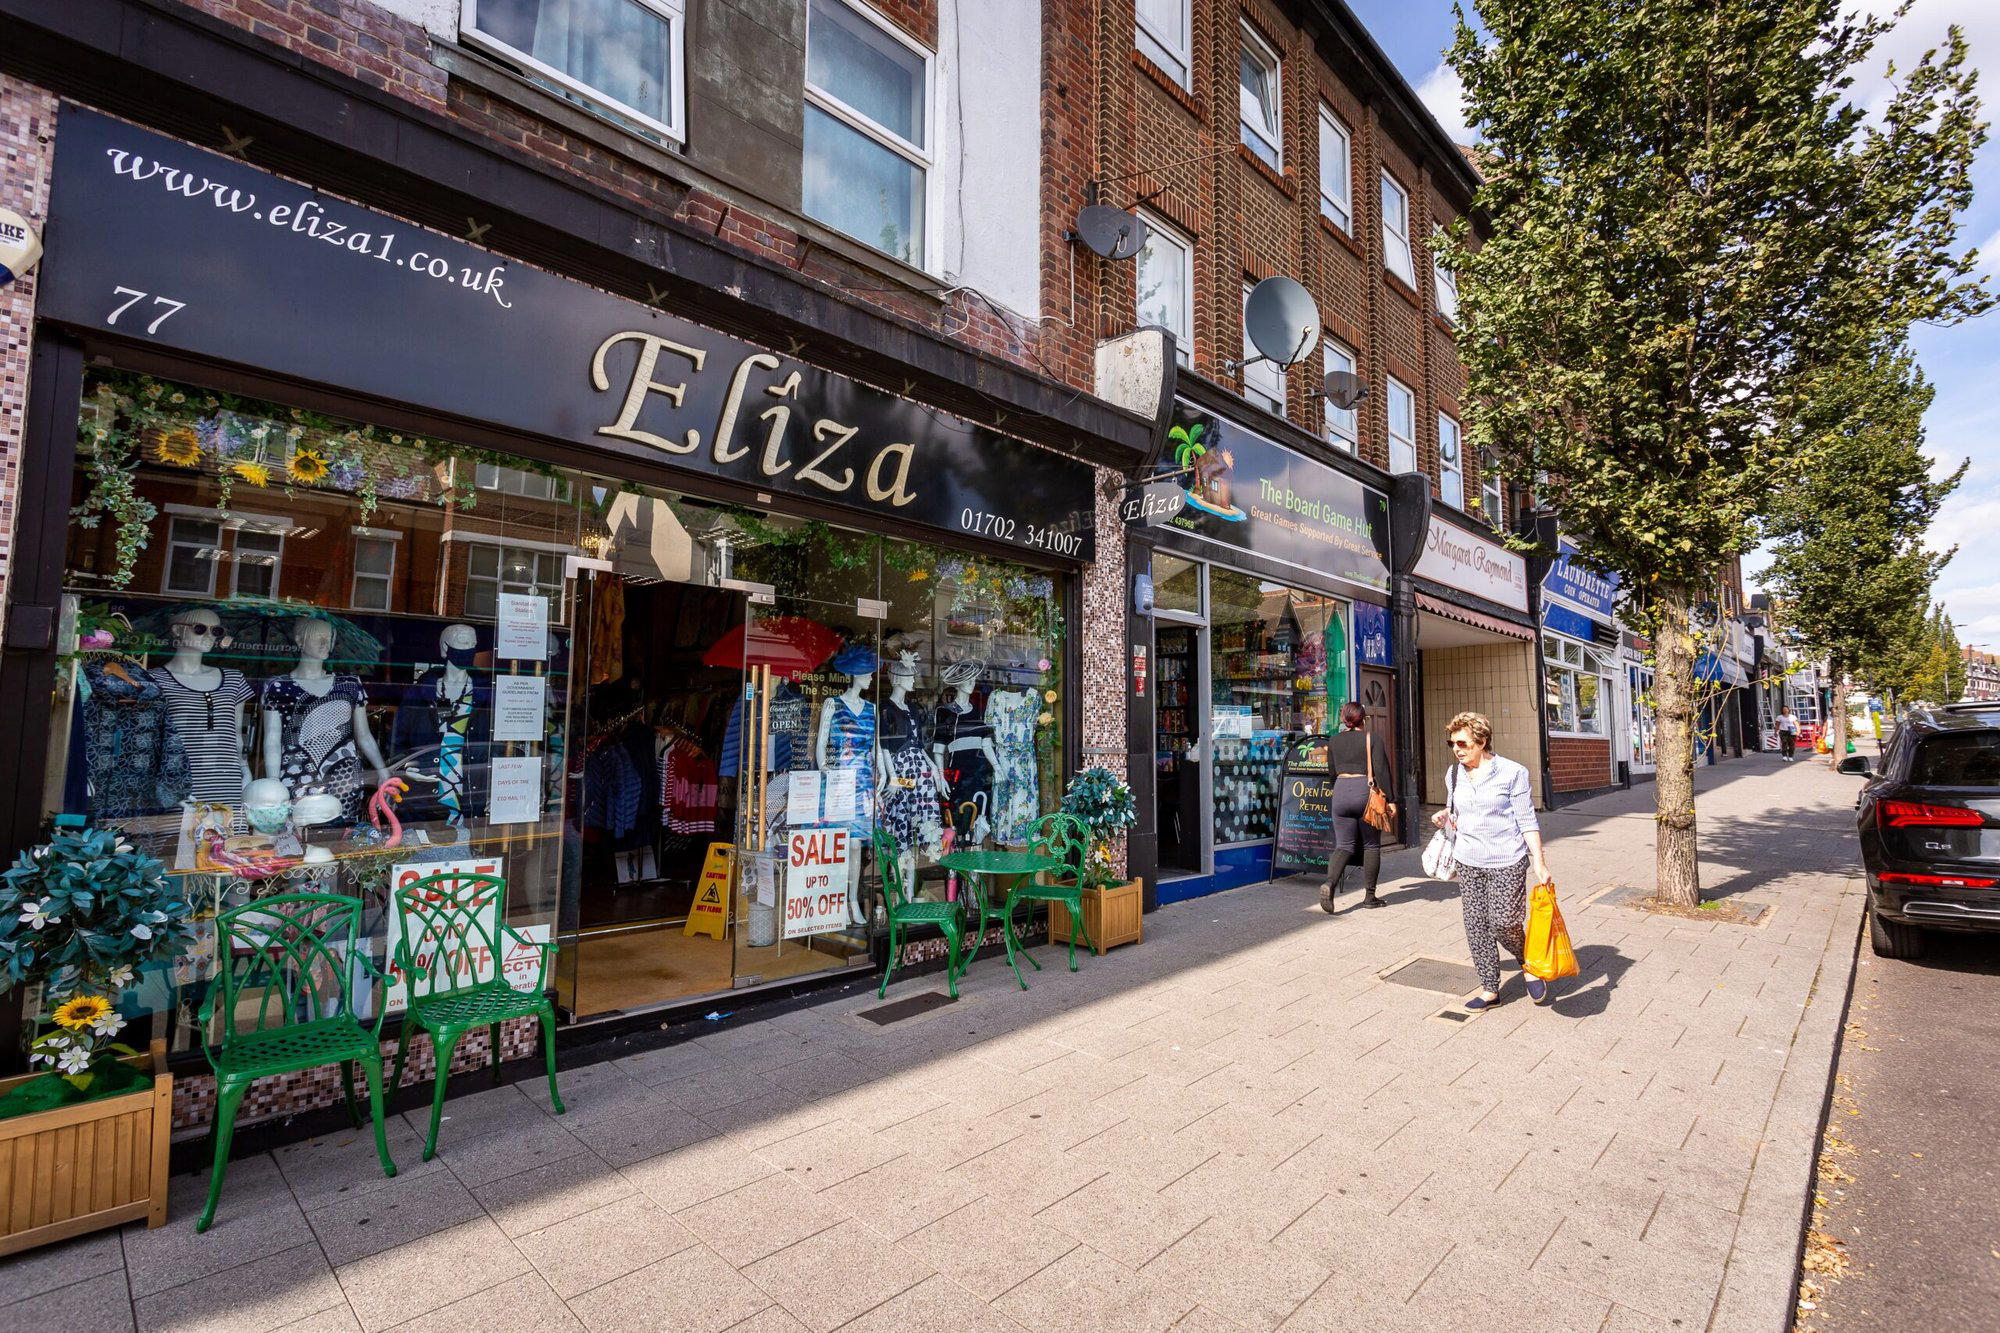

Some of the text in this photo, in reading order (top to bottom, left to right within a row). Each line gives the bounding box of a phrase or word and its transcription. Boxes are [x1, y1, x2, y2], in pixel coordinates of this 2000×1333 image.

[0, 222, 25, 240] KE
[107, 148, 512, 308] www.eliza1.co.uk
[106, 285, 187, 335] 77
[590, 331, 918, 507] Eliza
[1122, 492, 1181, 522] Eliza
[1259, 477, 1373, 541] The Board Game Hut
[961, 507, 1083, 557] 01702 341007
[1250, 505, 1272, 523] Great
[1273, 512, 1298, 531] Games
[1299, 520, 1334, 546] Supported
[1334, 535, 1343, 549] By
[1343, 538, 1360, 553] Great
[1426, 526, 1472, 571] Margaret
[1556, 559, 1610, 599] LAUNDRETTE
[791, 670, 852, 683] Please Mind
[799, 684, 844, 698] The Step
[772, 720, 798, 730] OPEN
[1292, 780, 1319, 798] OPEN
[1299, 798, 1329, 812] RETAIL
[791, 832, 847, 868] SALE
[1281, 853, 1293, 863] NO
[398, 865, 495, 914] SALE
[706, 871, 727, 880] CAUTION
[806, 875, 829, 889] UP TO
[787, 892, 846, 921] 50% OFF
[797, 924, 825, 934] SELECTED
[825, 922, 843, 930] ITEMS
[444, 946, 492, 977] OFF
[518, 972, 528, 981] in
[389, 999, 404, 1007] ON
